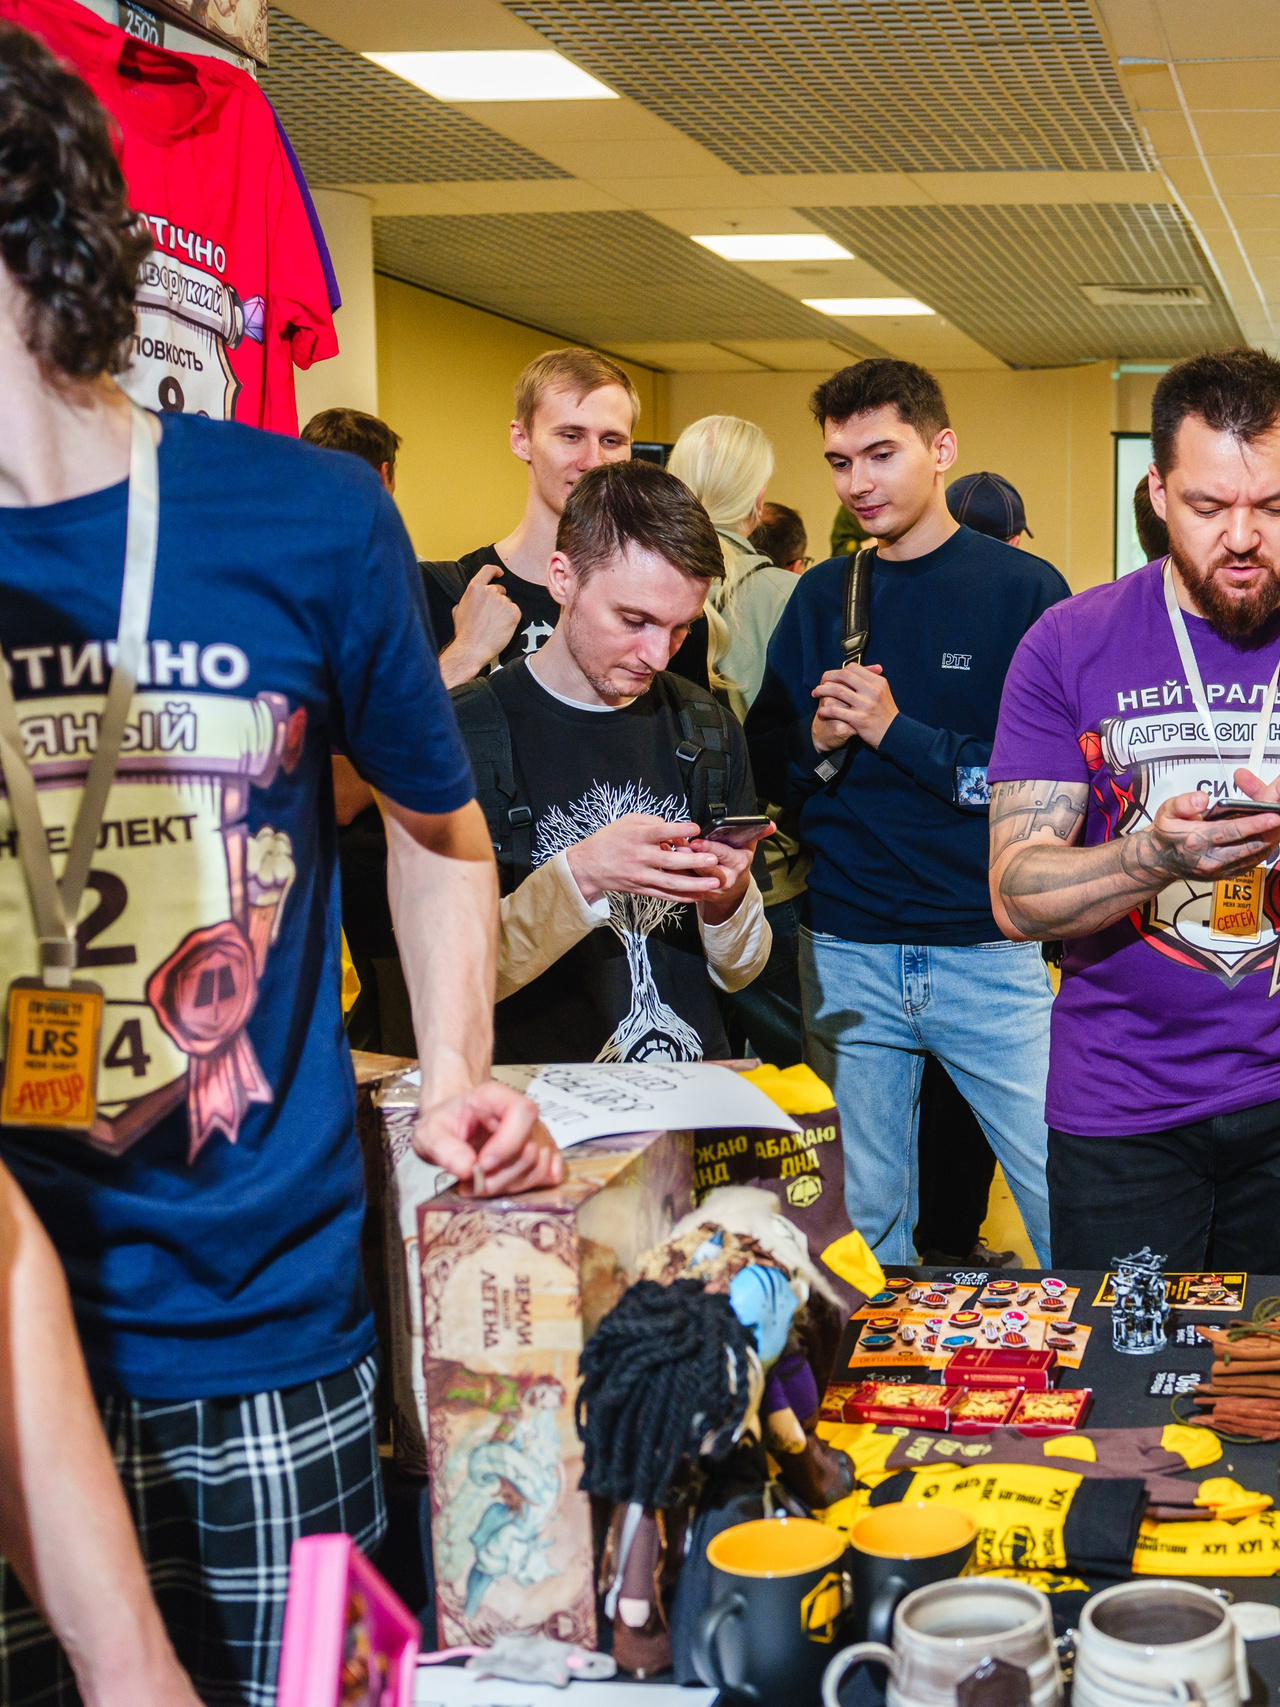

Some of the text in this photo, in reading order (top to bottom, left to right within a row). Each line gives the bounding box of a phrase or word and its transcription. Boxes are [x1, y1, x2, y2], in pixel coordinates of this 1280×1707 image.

[124, 9, 159, 46] 2500
[0, 813, 197, 858] НЕЛЕКТ
[1224, 883, 1252, 901] LRS
[1217, 909, 1256, 932] СЕРГЕЙ
[27, 1028, 78, 1057] LRS
[11, 1072, 86, 1118] АРТУР
[779, 1147, 821, 1180] ДНД
[480, 1268, 498, 1349] ЛЕГЕНД
[514, 1272, 534, 1347] ЗЕМЛИ
